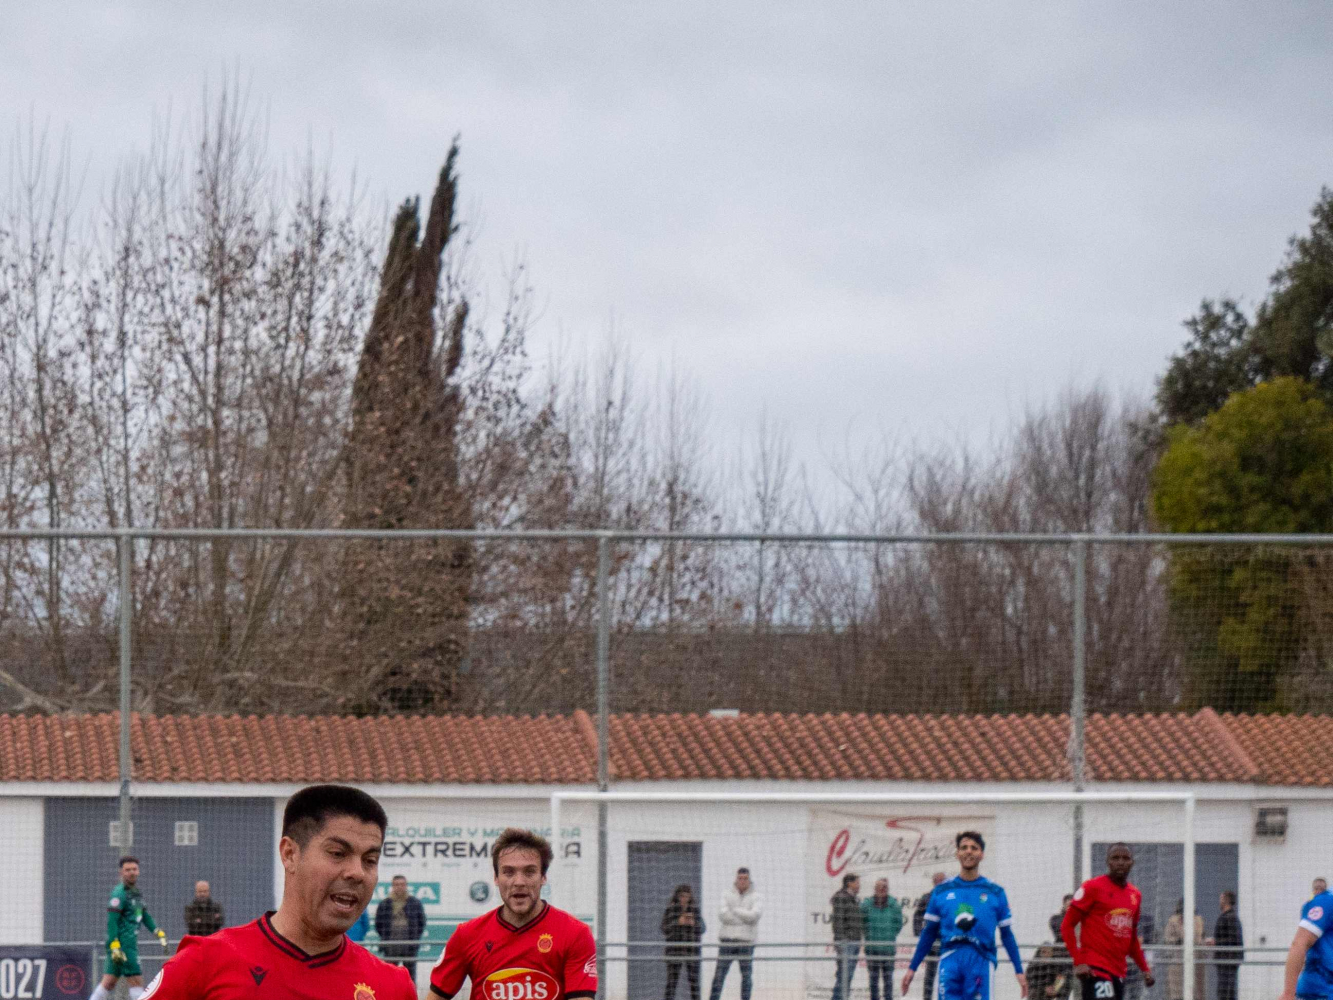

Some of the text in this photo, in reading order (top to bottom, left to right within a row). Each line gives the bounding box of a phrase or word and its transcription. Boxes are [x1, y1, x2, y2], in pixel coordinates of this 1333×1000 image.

[467, 826, 479, 837] Y
[383, 841, 581, 858] EXTREMA
[1093, 980, 1115, 999] 20
